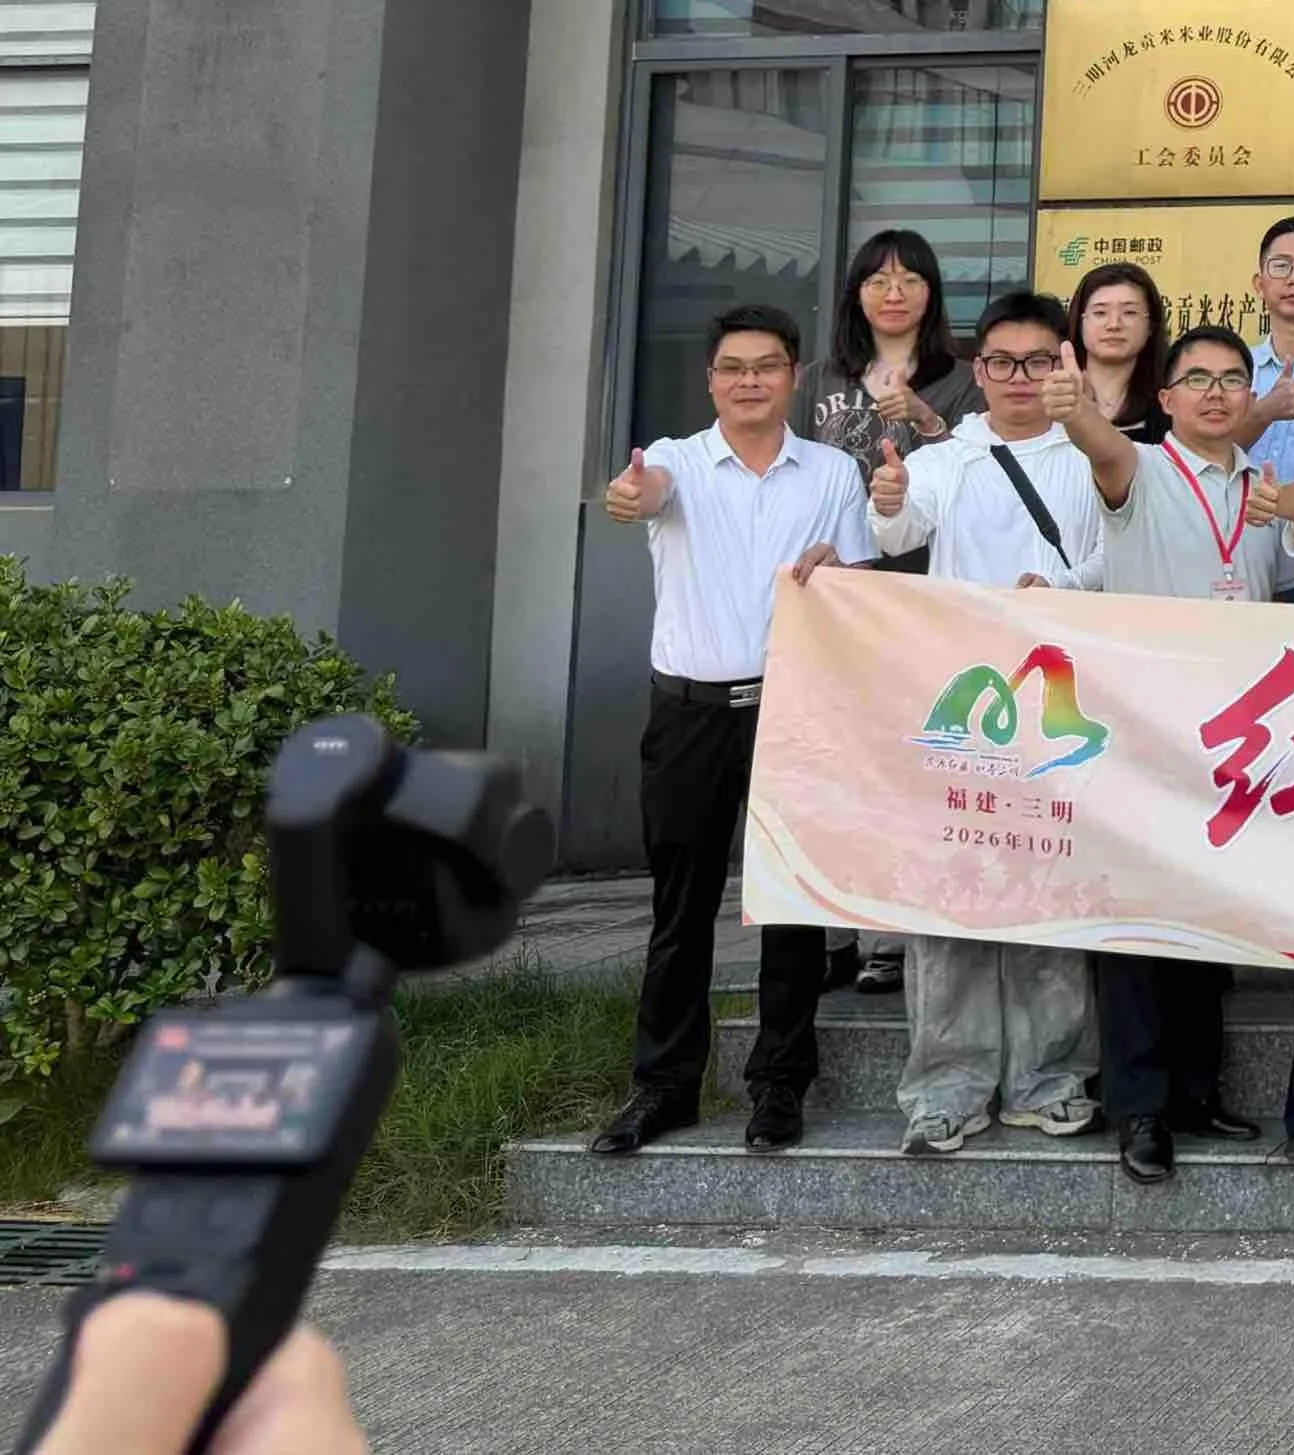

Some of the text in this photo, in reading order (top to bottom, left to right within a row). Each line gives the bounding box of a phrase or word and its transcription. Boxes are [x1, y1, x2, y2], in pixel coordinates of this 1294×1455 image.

[1134, 145, 1252, 167] 工会委员会
[1094, 237, 1163, 255] 中国邮政
[815, 388, 880, 426] ORI
[945, 787, 1074, 824] 福建·三明
[943, 825, 1073, 857] 2026年10月
